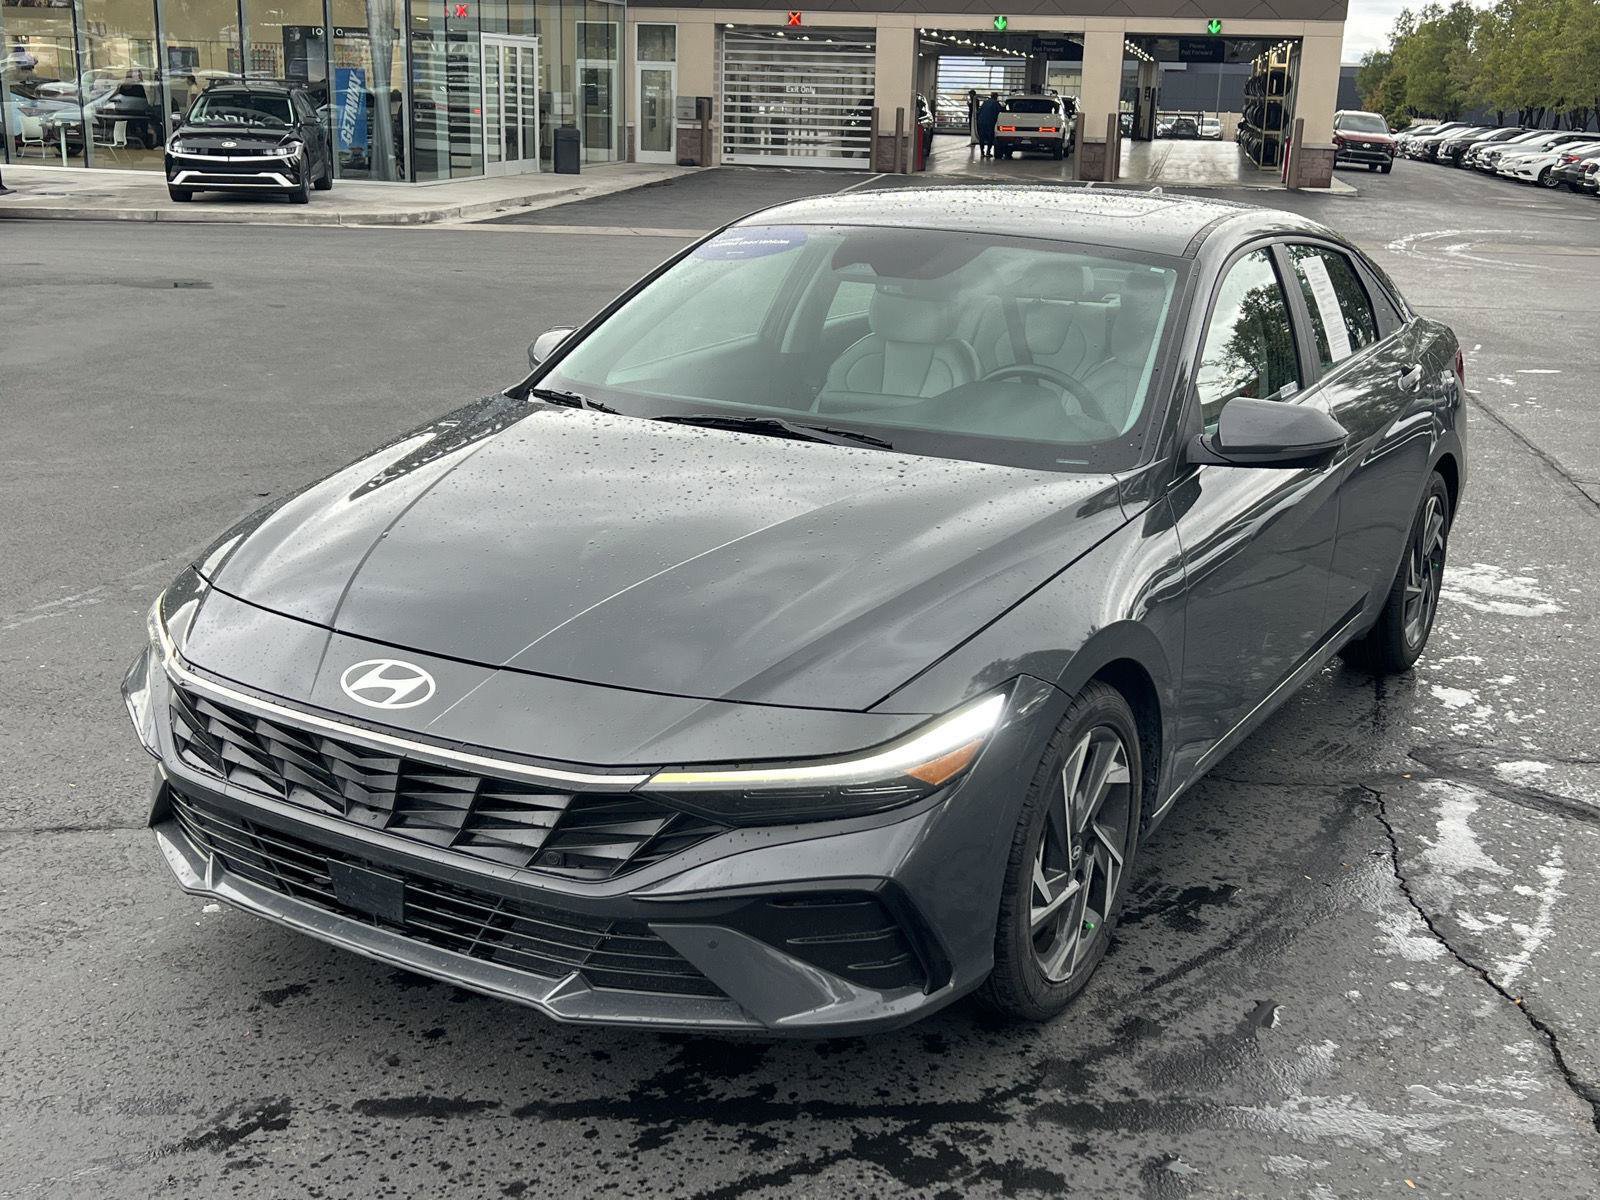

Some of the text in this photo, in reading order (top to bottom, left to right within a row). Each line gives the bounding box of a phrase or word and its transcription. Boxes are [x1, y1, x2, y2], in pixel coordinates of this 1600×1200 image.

[341, 69, 361, 146] GETAWAY
[785, 84, 816, 95] Exit Only
